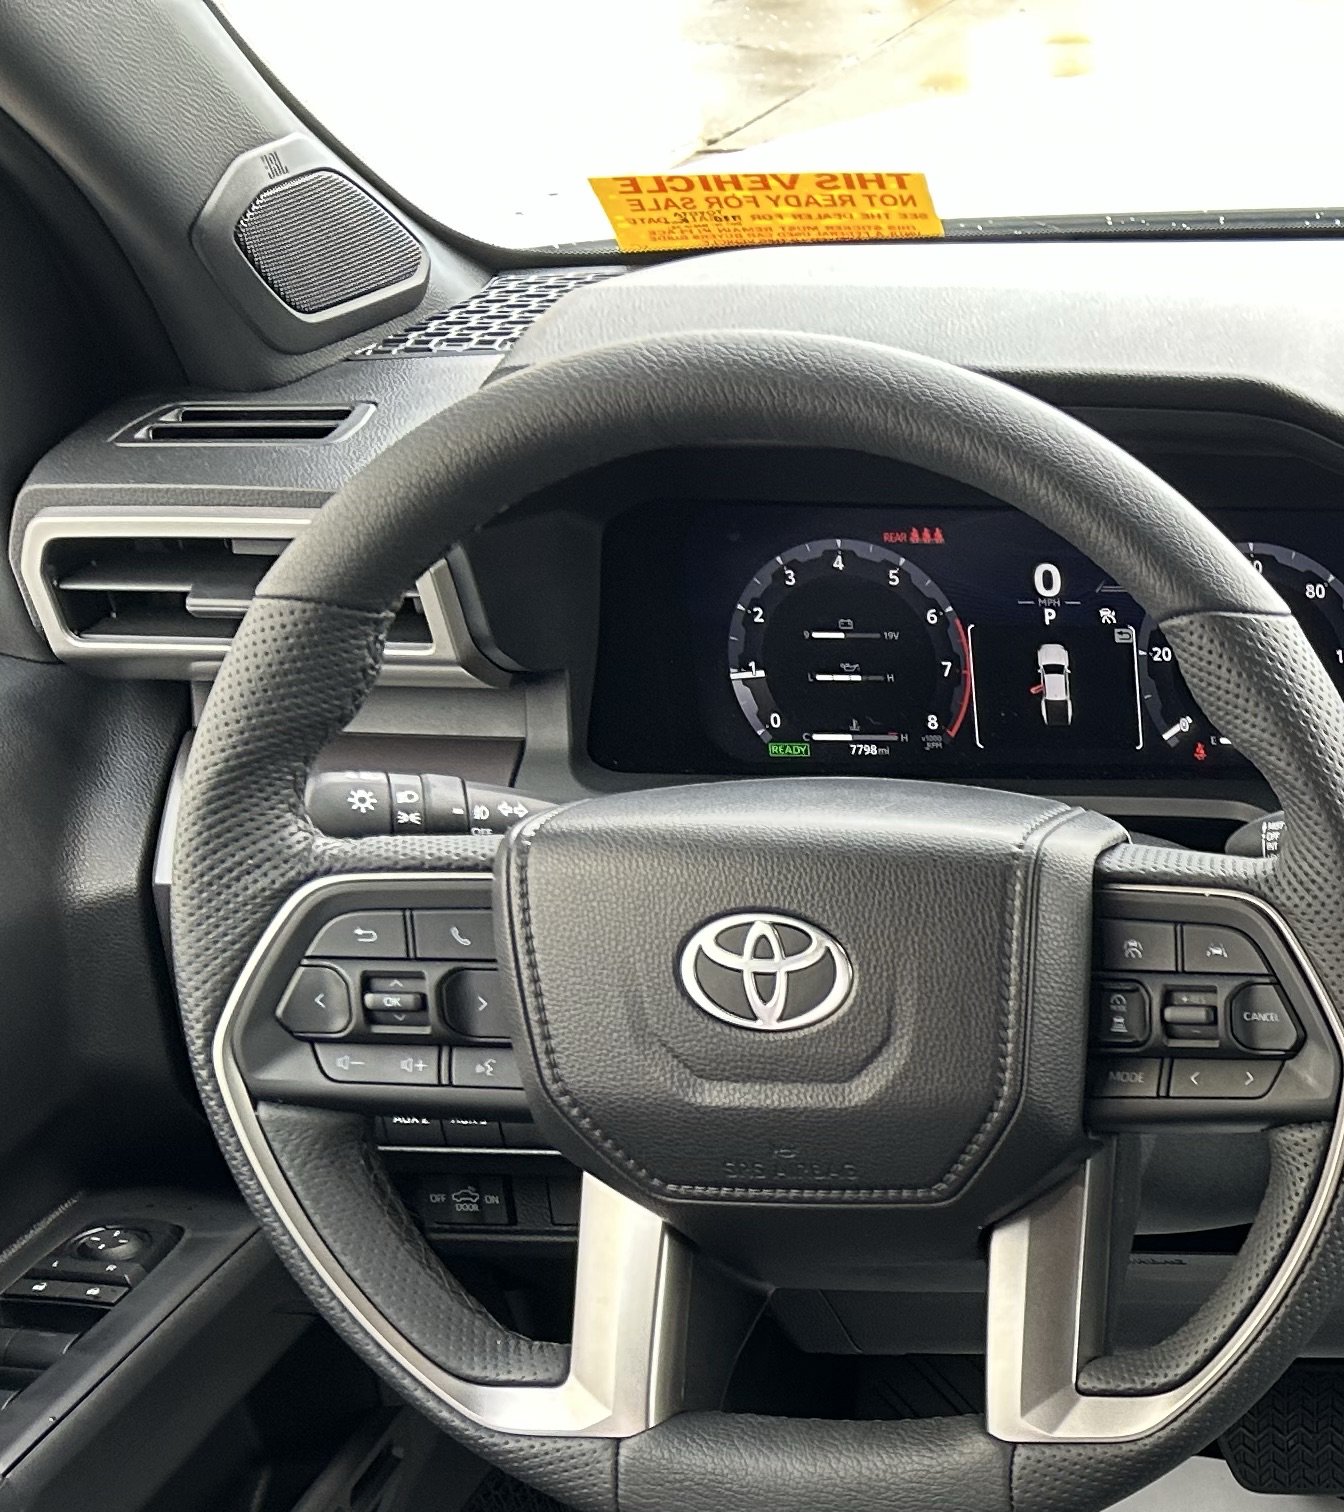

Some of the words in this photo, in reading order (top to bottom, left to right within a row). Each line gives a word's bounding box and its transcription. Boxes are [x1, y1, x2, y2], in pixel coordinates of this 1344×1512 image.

[883, 532, 907, 543] REAR
[832, 555, 844, 571] 4
[784, 569, 797, 586] 3
[887, 569, 900, 586] 5
[1034, 563, 1062, 598] 0
[1305, 584, 1326, 599] 80
[1038, 597, 1060, 607] MPH
[752, 607, 765, 624] 2
[926, 608, 939, 625] 6
[1044, 608, 1056, 625] P
[884, 630, 900, 641] 19V
[1152, 647, 1172, 662] 20
[940, 661, 952, 678] 7
[886, 674, 895, 684] H
[770, 712, 781, 727] 0
[927, 714, 939, 730] 8
[802, 732, 811, 743] C
[900, 732, 909, 743] H
[771, 743, 807, 756] READY
[849, 744, 878, 756] 7798
[878, 747, 890, 755] mi
[1243, 1011, 1280, 1022] CANCEL
[1108, 1071, 1145, 1084] MODE
[430, 1194, 446, 1203] OFF
[485, 1195, 499, 1204] ON
[456, 1203, 479, 1211] DOOR
